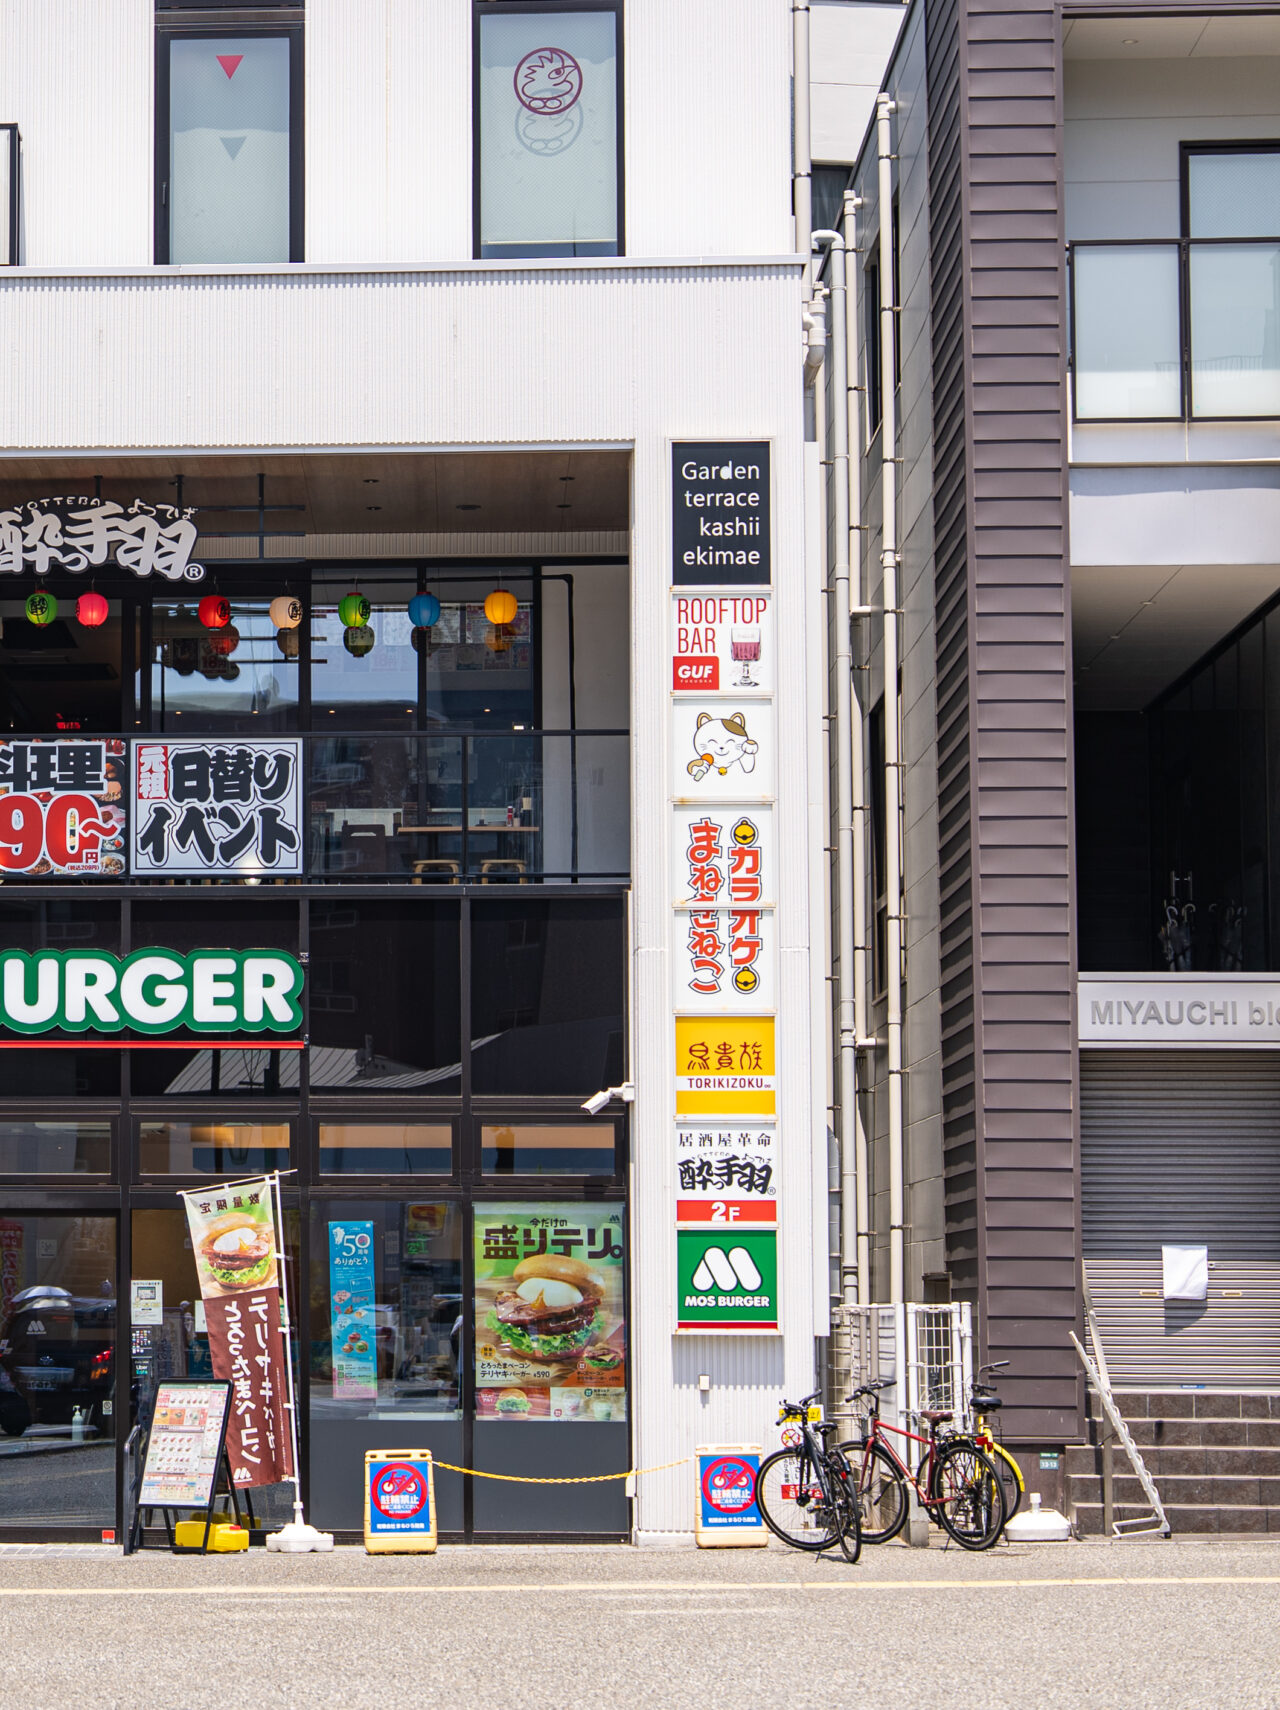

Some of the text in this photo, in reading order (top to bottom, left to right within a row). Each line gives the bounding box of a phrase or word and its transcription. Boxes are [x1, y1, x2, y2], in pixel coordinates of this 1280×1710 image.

[681, 461, 760, 481] Garden
[14, 496, 101, 514] YOTTEBA
[684, 490, 760, 507] terrace
[699, 517, 760, 536] kashii
[683, 546, 760, 565] ekimae
[677, 598, 767, 625] ROOFTOP
[677, 627, 716, 654] BAR
[677, 665, 714, 679] GUF
[138, 746, 168, 799] 元祖
[173, 747, 293, 803] 日替り
[139, 805, 299, 866] イベント
[85, 853, 98, 864] 円
[729, 846, 763, 970] カラオケ
[1090, 1000, 1237, 1026] MIYAUCHI
[678, 1132, 772, 1148] 居酒屋革命
[711, 1202, 740, 1222] 2F
[529, 1217, 568, 1228] 今だけの
[334, 1256, 369, 1266] ありがとう
[684, 1296, 770, 1308] MOS BURGER
